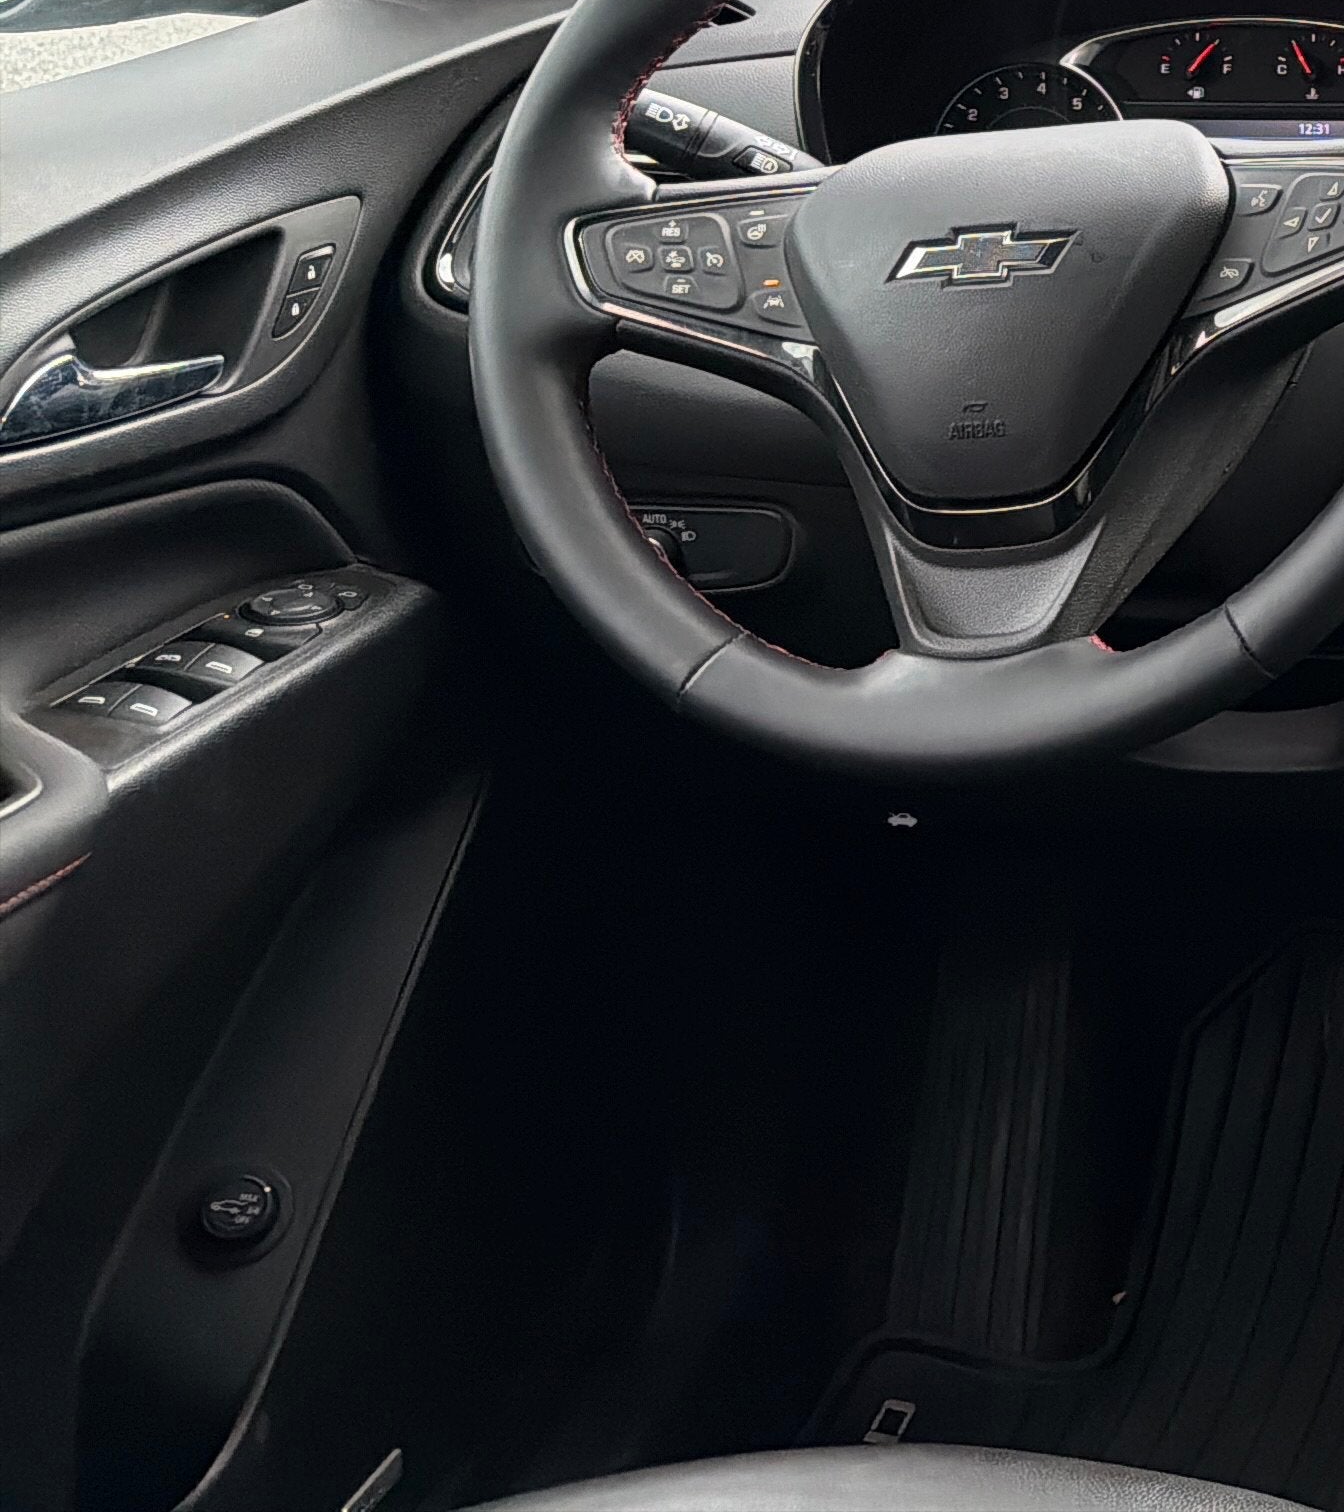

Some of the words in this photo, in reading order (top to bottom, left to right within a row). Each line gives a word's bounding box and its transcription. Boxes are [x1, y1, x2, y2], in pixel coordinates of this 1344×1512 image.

[1160, 64, 1171, 74] E
[1222, 64, 1233, 75] F
[1276, 64, 1288, 75] C
[999, 86, 1010, 100] 3
[1036, 82, 1047, 95] 4
[1071, 97, 1083, 111] 5
[966, 108, 978, 122] 2
[1298, 123, 1330, 135] 12:31
[662, 227, 681, 237] RES
[671, 284, 691, 294] SET
[948, 419, 1007, 440] AIRBAG
[643, 513, 667, 524] AUTO
